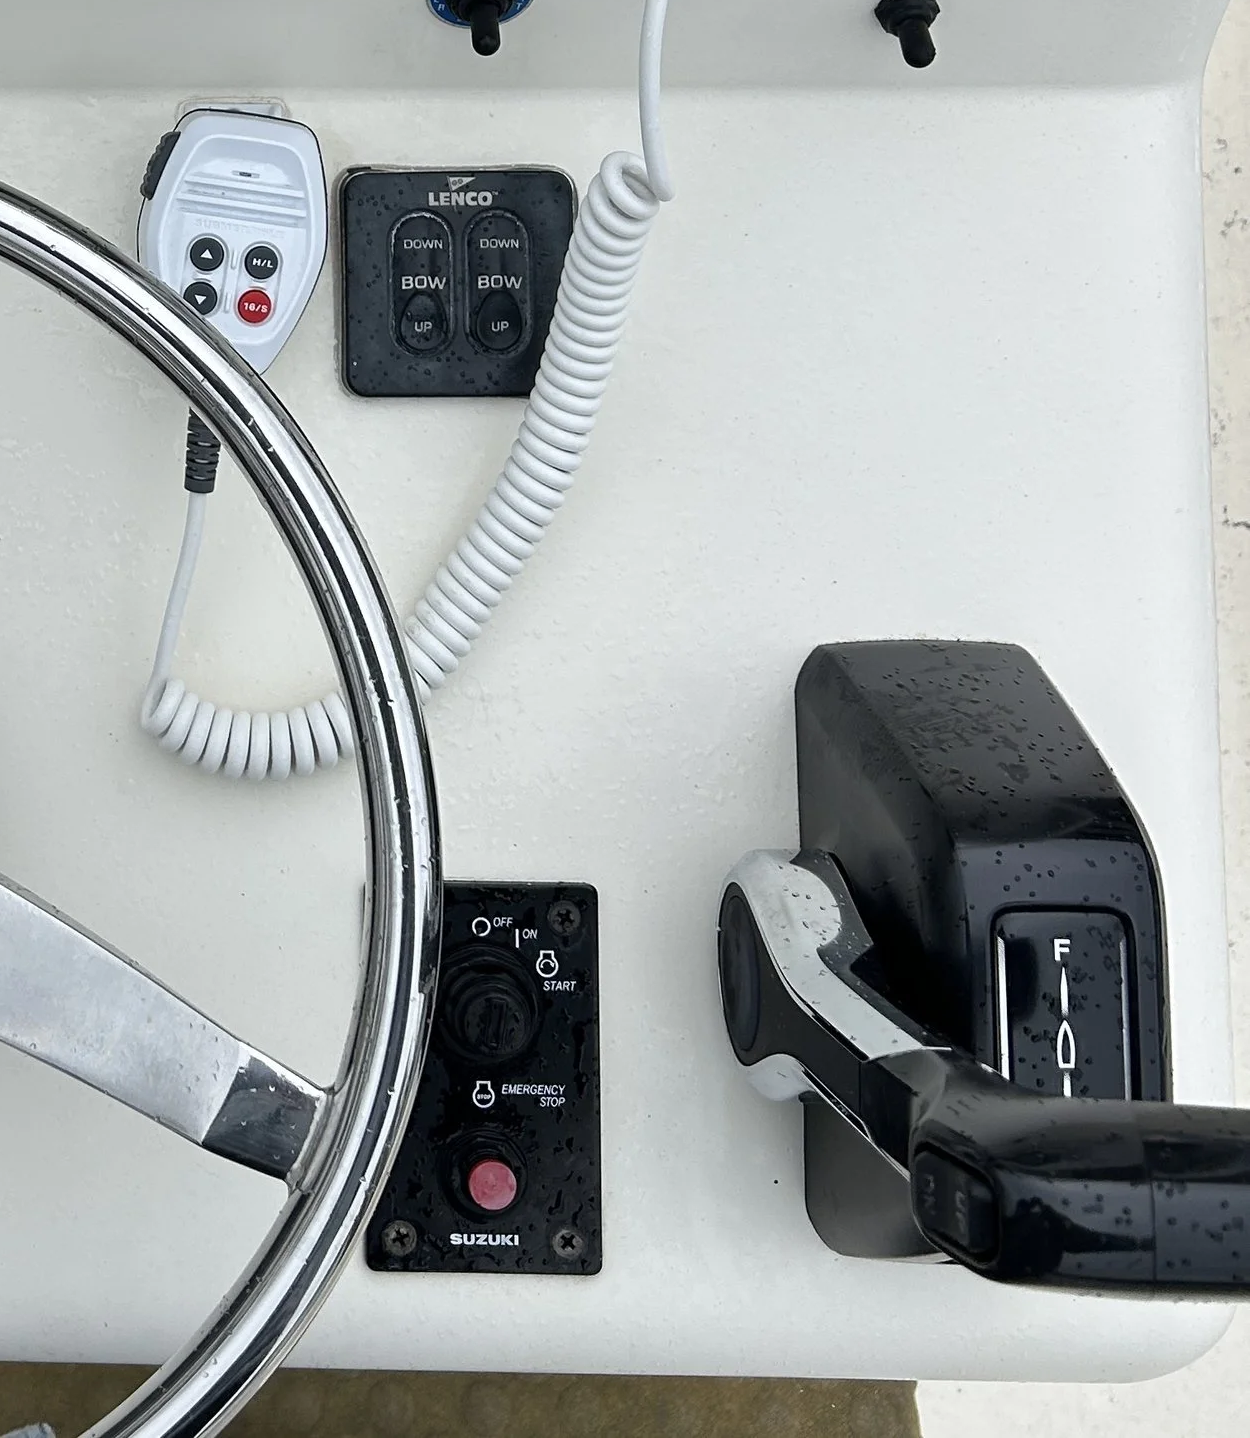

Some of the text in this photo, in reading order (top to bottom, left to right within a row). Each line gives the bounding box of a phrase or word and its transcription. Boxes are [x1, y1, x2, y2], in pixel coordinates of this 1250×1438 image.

[403, 238, 443, 249] DOWN
[479, 238, 520, 249] DOWN
[252, 257, 274, 268] H/L
[401, 275, 447, 290] BOW
[477, 275, 523, 289] BOW
[243, 301, 268, 313] 16/S
[414, 322, 433, 332] UP
[491, 321, 510, 332] UP
[493, 917, 513, 927] OFF
[522, 928, 538, 939] ON
[1053, 938, 1070, 961] F
[543, 980, 576, 991] START
[501, 1083, 566, 1095] EMERGENCY
[539, 1096, 566, 1108] STOP
[449, 1233, 519, 1245] SUZUKI
